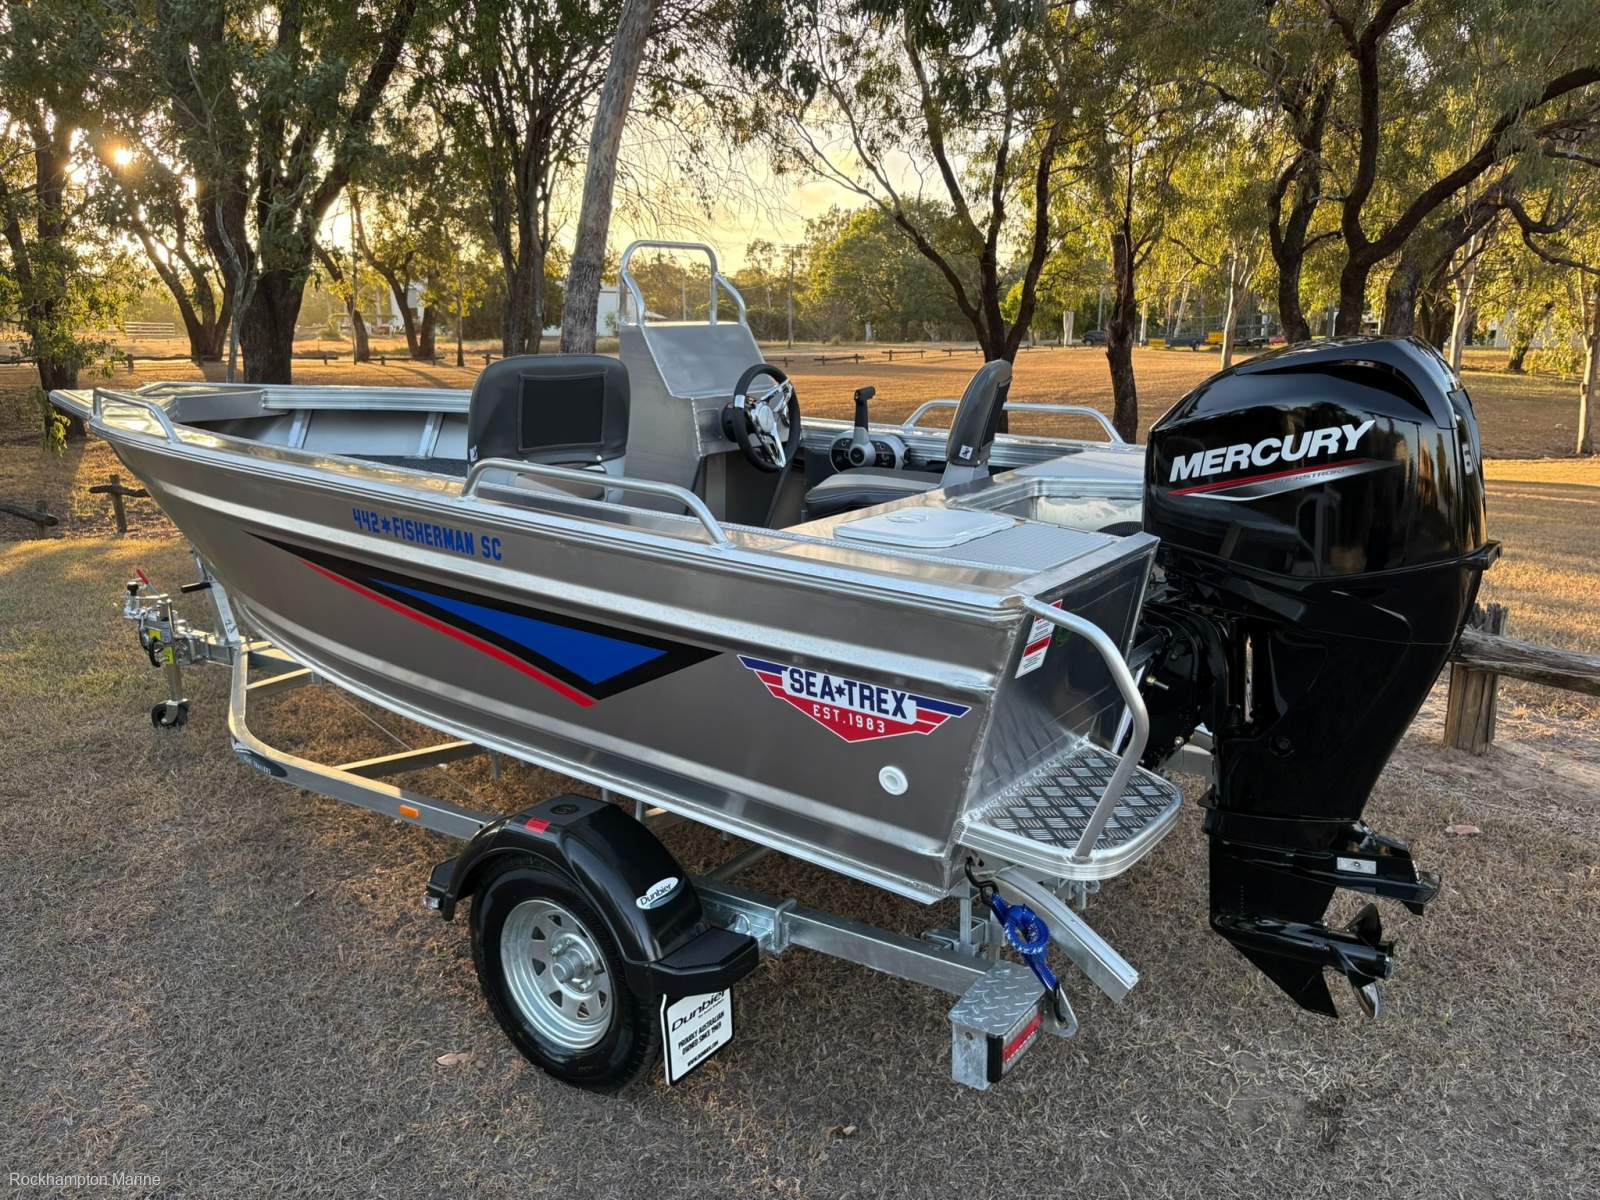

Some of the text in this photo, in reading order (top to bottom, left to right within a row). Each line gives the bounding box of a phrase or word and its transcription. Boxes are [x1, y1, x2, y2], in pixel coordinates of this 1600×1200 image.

[1168, 419, 1376, 483] MERCURY
[352, 508, 502, 561] 442 FISHERMAN SC
[640, 882, 672, 906] Dunbier
[671, 989, 725, 1032] Dunbier
[678, 1010, 725, 1049] PROUDLY AUSTRALIAN
[682, 1038, 699, 1056] OWNED
[699, 1028, 711, 1043] SINCE
